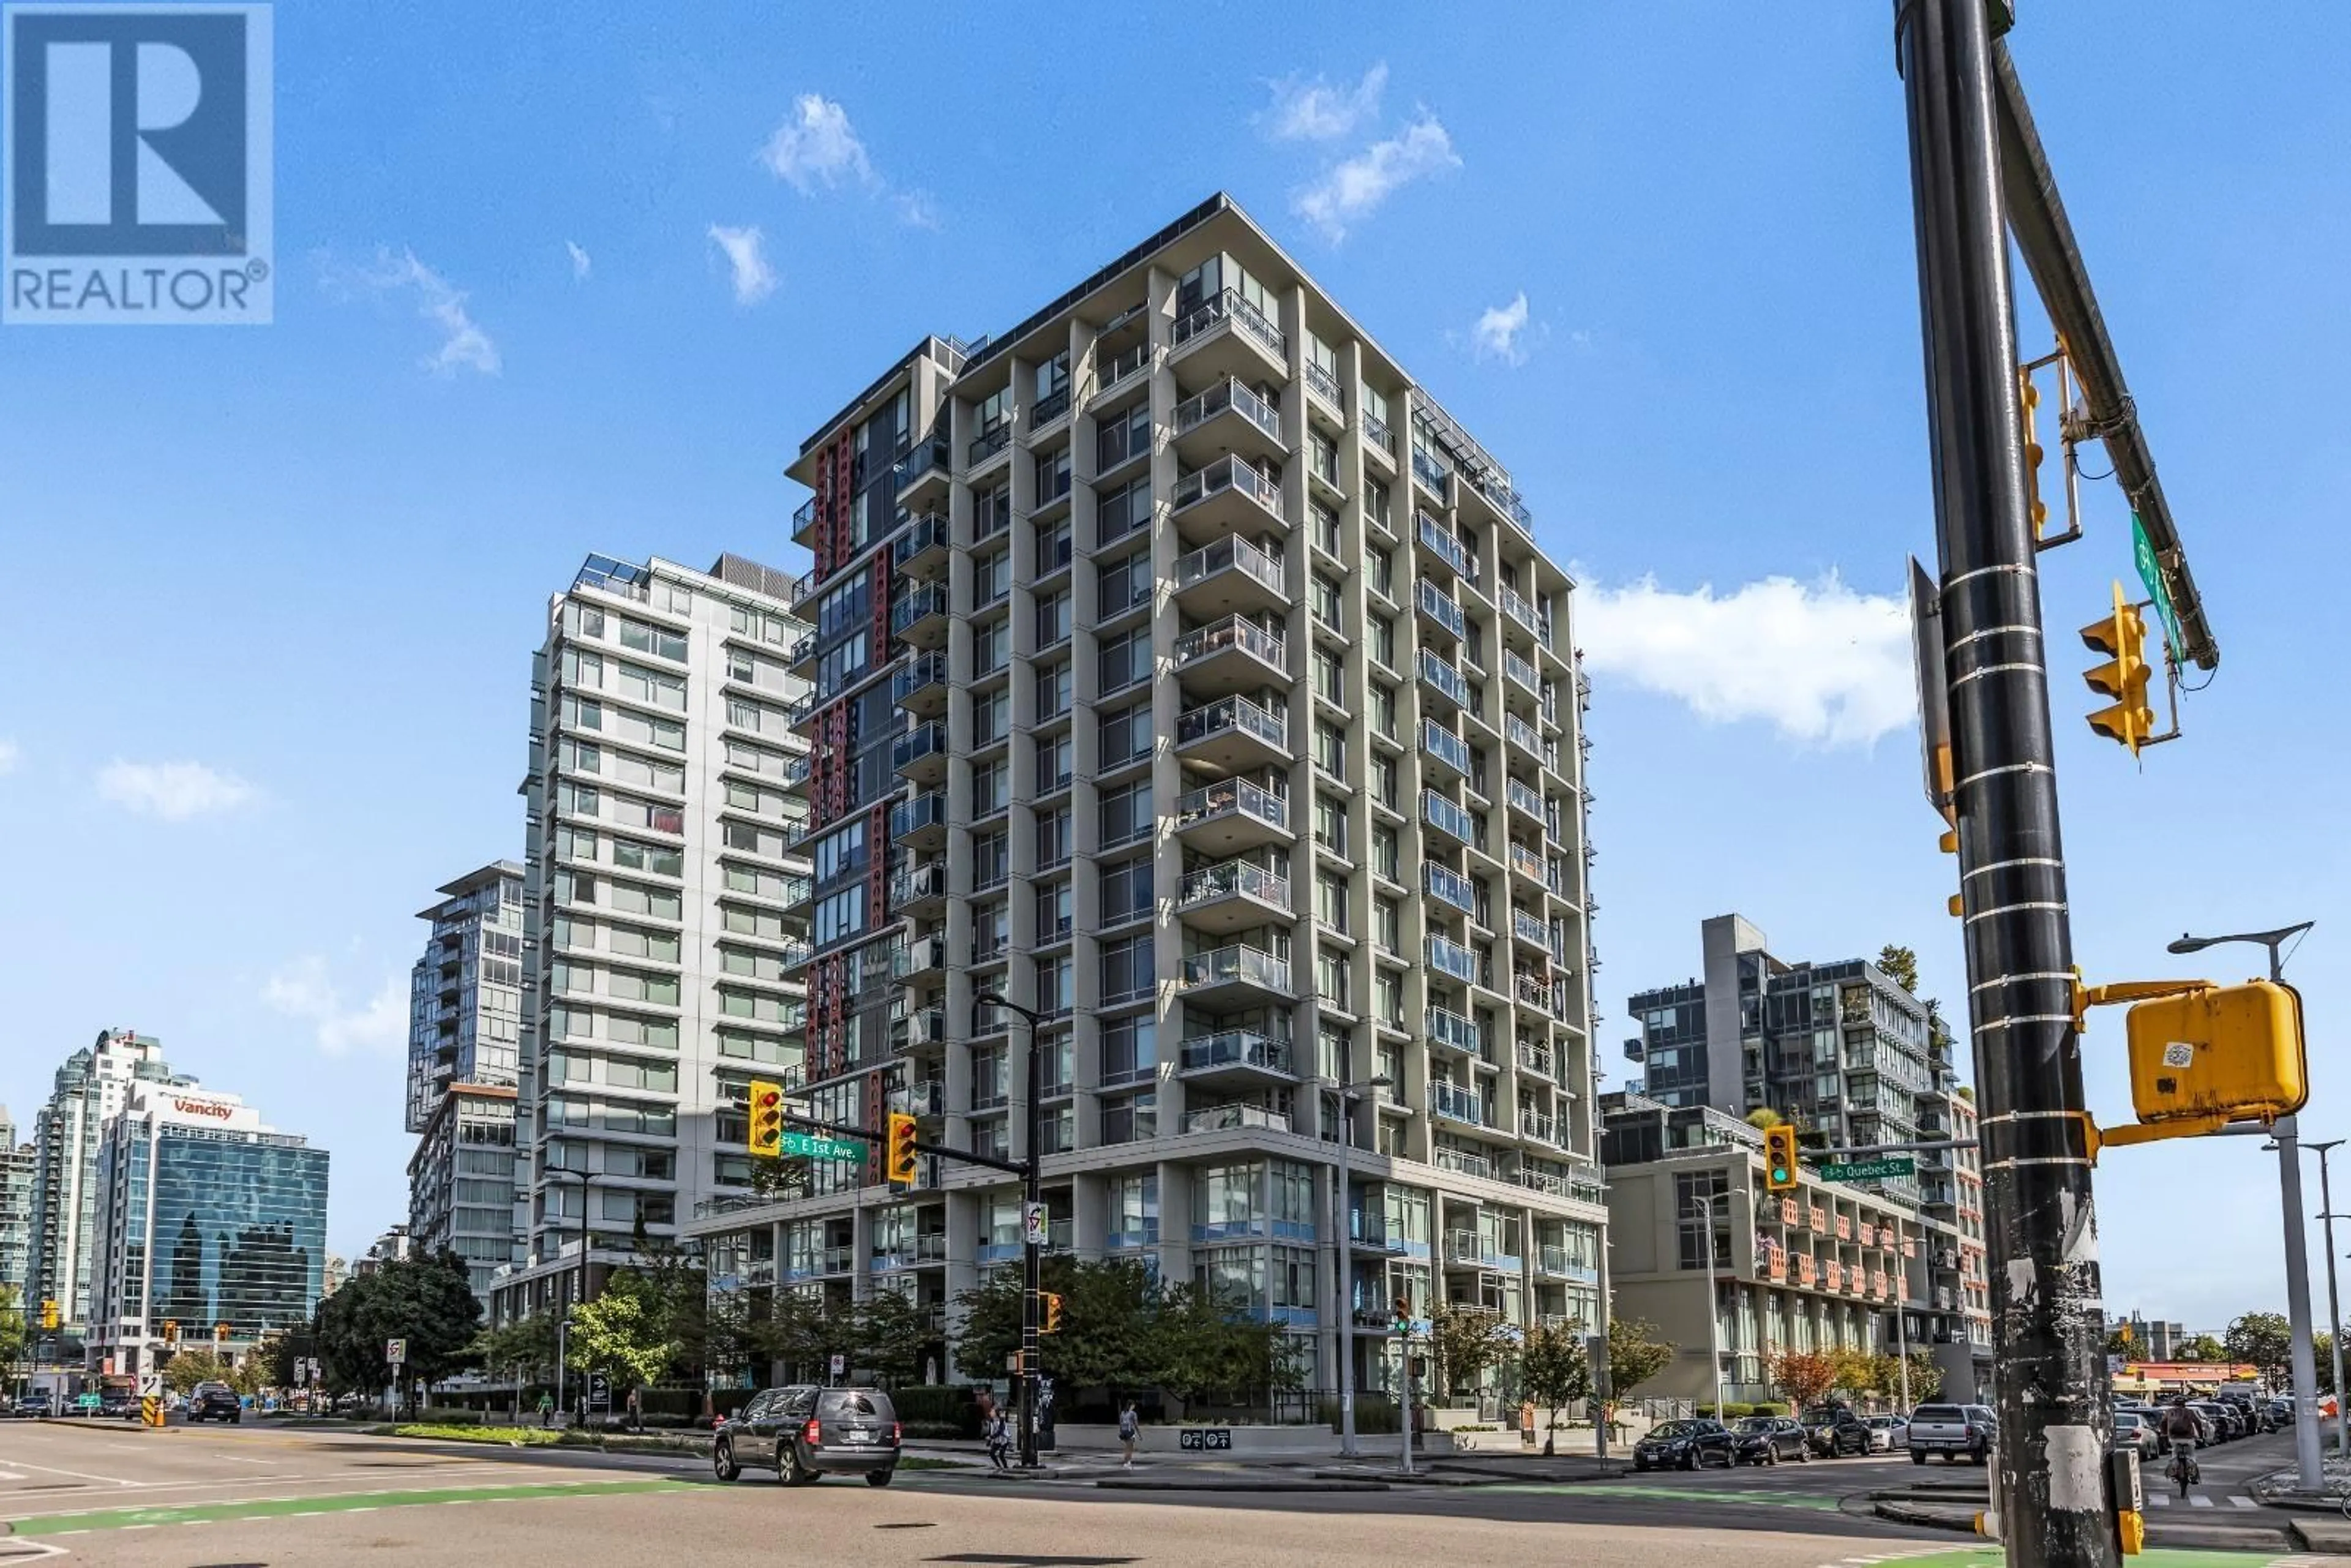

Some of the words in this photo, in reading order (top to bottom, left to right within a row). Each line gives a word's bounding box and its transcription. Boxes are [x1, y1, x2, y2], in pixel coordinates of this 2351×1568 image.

[174, 1099, 233, 1120] Vancity
[802, 1139, 809, 1151] E
[812, 1141, 830, 1155] 1st
[833, 1144, 856, 1159] Ave.
[1847, 1164, 1888, 1177] Quebec
[1889, 1162, 1905, 1174] St.
